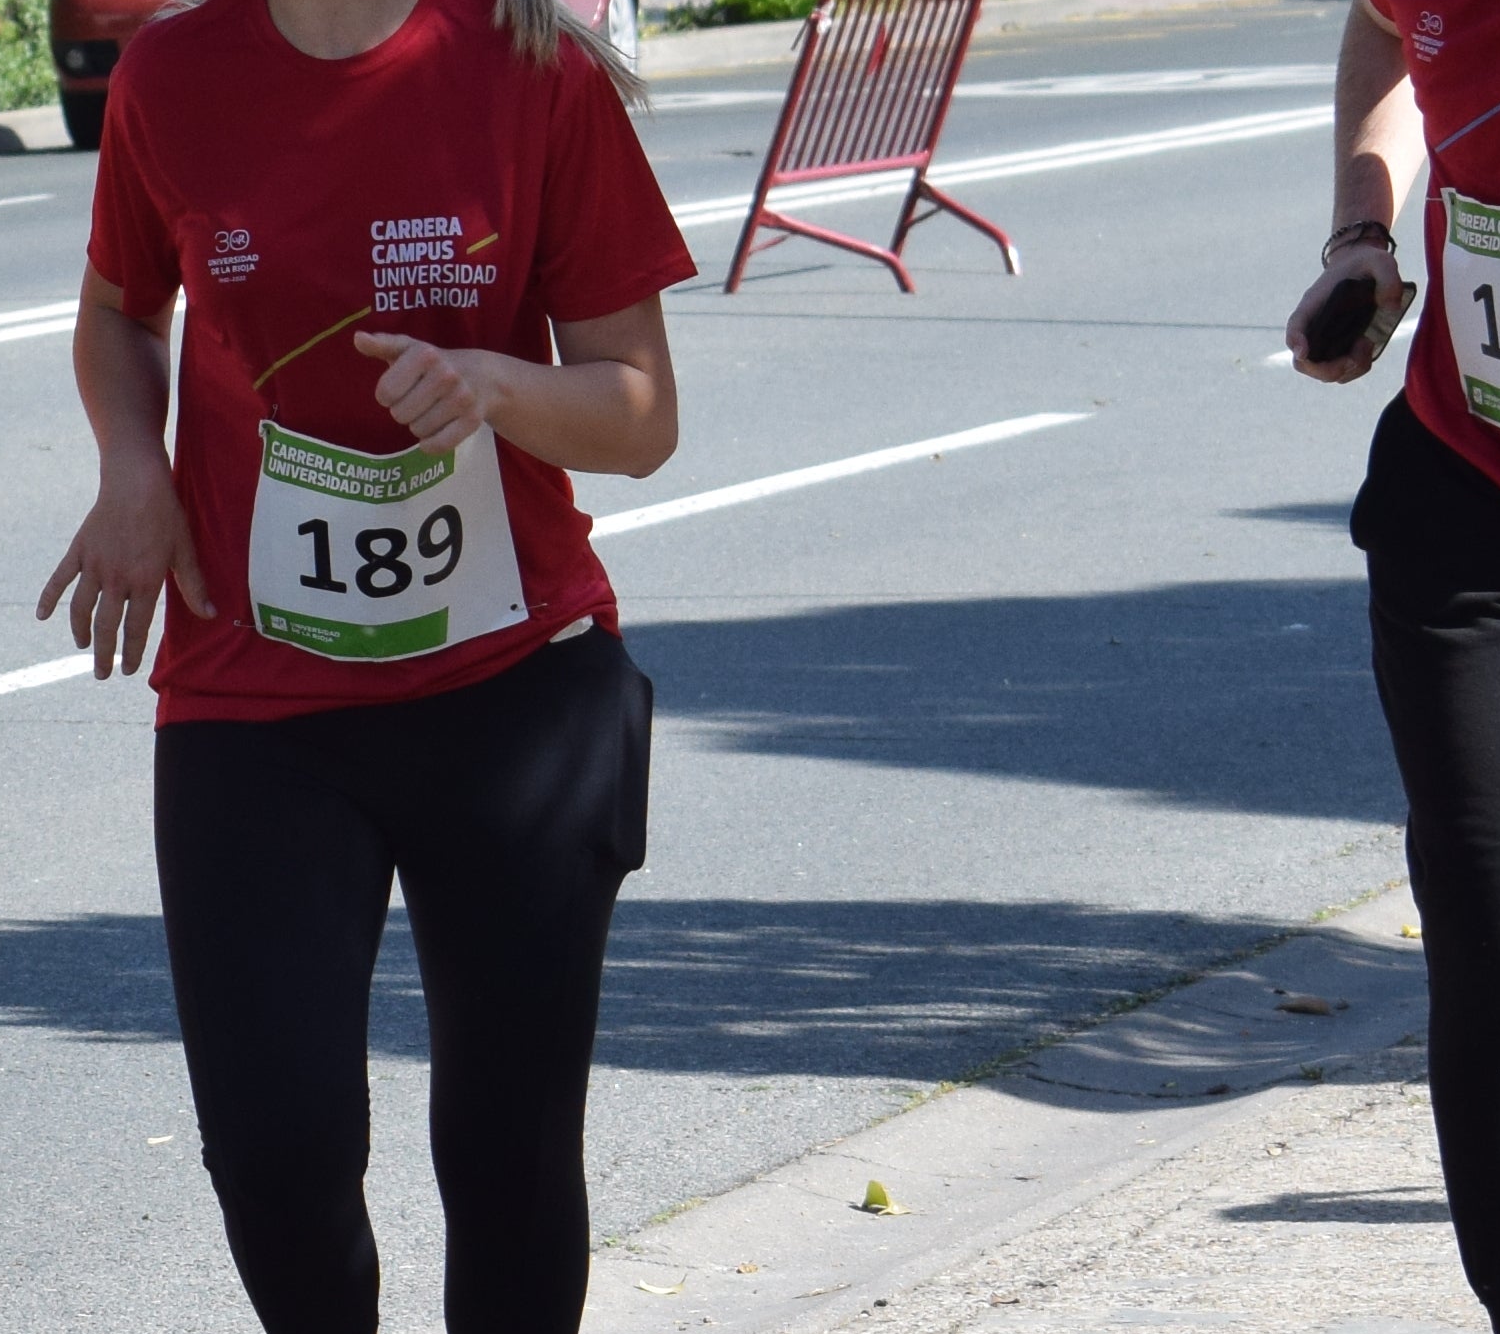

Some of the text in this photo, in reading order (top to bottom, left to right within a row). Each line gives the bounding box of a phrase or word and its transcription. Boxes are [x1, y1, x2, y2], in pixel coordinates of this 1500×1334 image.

[214, 229, 250, 253] 30
[370, 216, 463, 241] CARRERA
[207, 253, 260, 267] UNIVERSIDAD
[371, 239, 455, 265] CAMPUS
[210, 263, 256, 276] DE LA RIOJA
[373, 263, 497, 288] UNIVERSIDAD
[375, 287, 480, 312] DE LA RIOJA
[271, 441, 402, 484] CARRERA CAMPUS
[268, 457, 446, 499] UNIVERSIDAD DE LA RIOJA
[297, 504, 463, 599] 189
